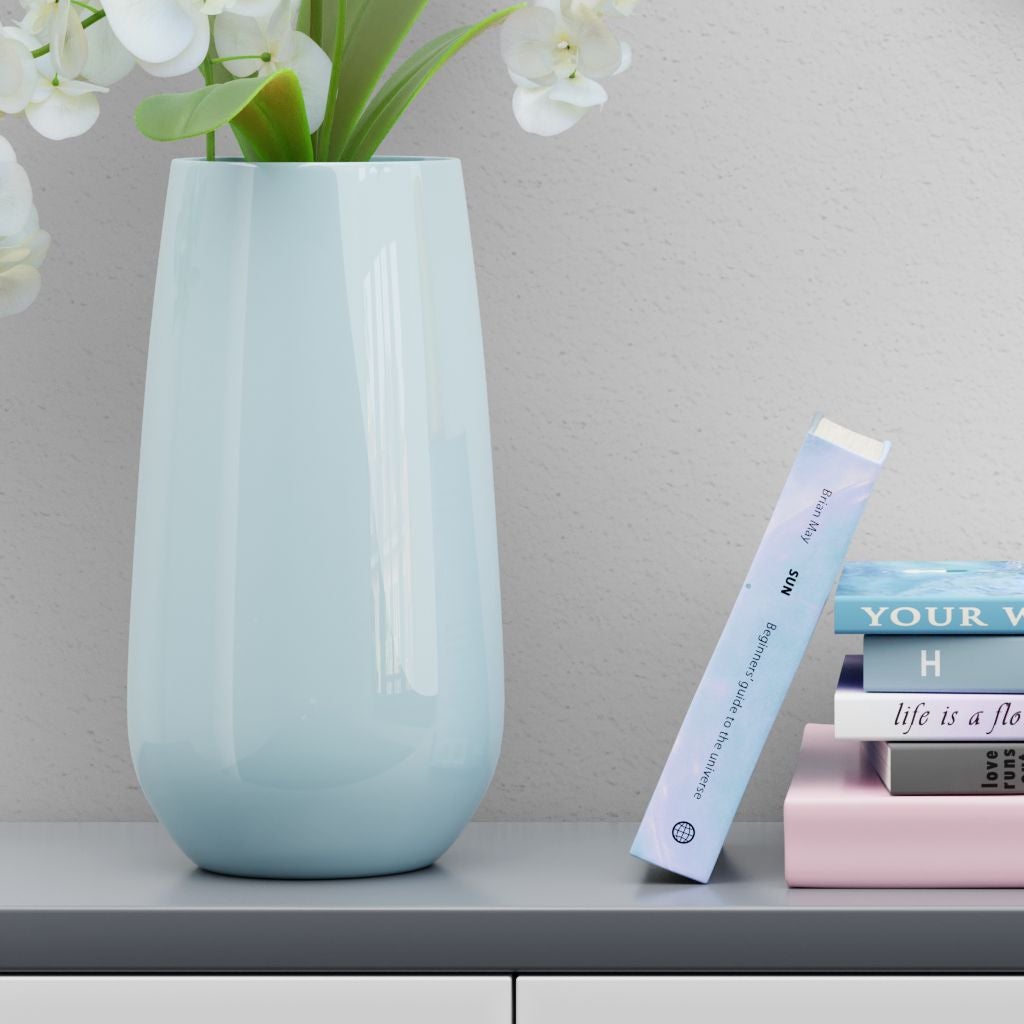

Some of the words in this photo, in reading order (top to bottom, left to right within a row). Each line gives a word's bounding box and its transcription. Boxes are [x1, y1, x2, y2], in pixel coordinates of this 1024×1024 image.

[813, 488, 833, 518] Brian
[800, 519, 820, 544] May
[780, 568, 799, 596] SUN
[861, 606, 989, 627] YOUR
[729, 680, 749, 714] guide
[723, 716, 735, 728] to
[894, 702, 930, 734] life
[940, 706, 958, 726] is
[968, 710, 984, 726] a
[714, 731, 729, 750] the
[693, 752, 719, 800] universe
[981, 750, 998, 788] love
[1003, 749, 1016, 789] runs
